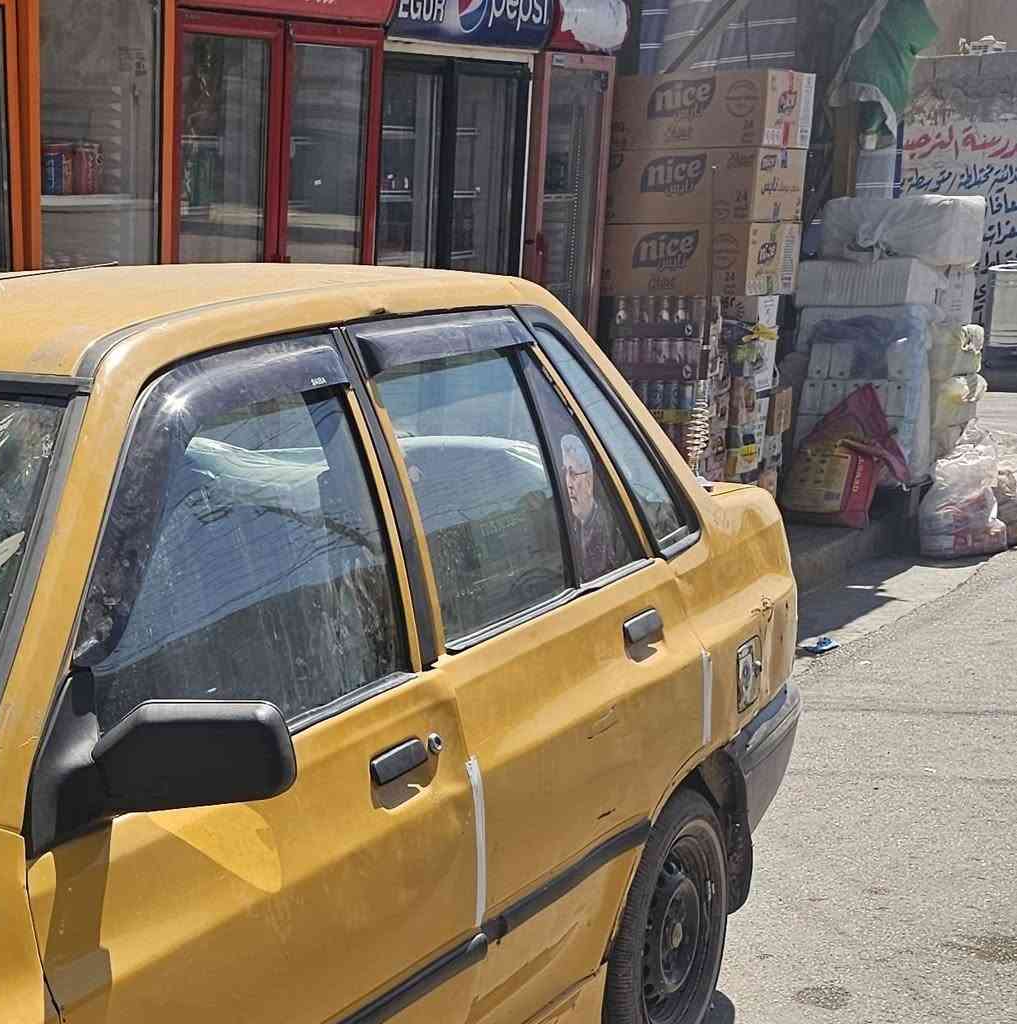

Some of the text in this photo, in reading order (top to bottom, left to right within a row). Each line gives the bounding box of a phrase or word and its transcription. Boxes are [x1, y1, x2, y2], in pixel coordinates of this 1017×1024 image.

[488, 0, 548, 31] pepsi
[647, 158, 703, 186] nice
[639, 234, 695, 262] nice
